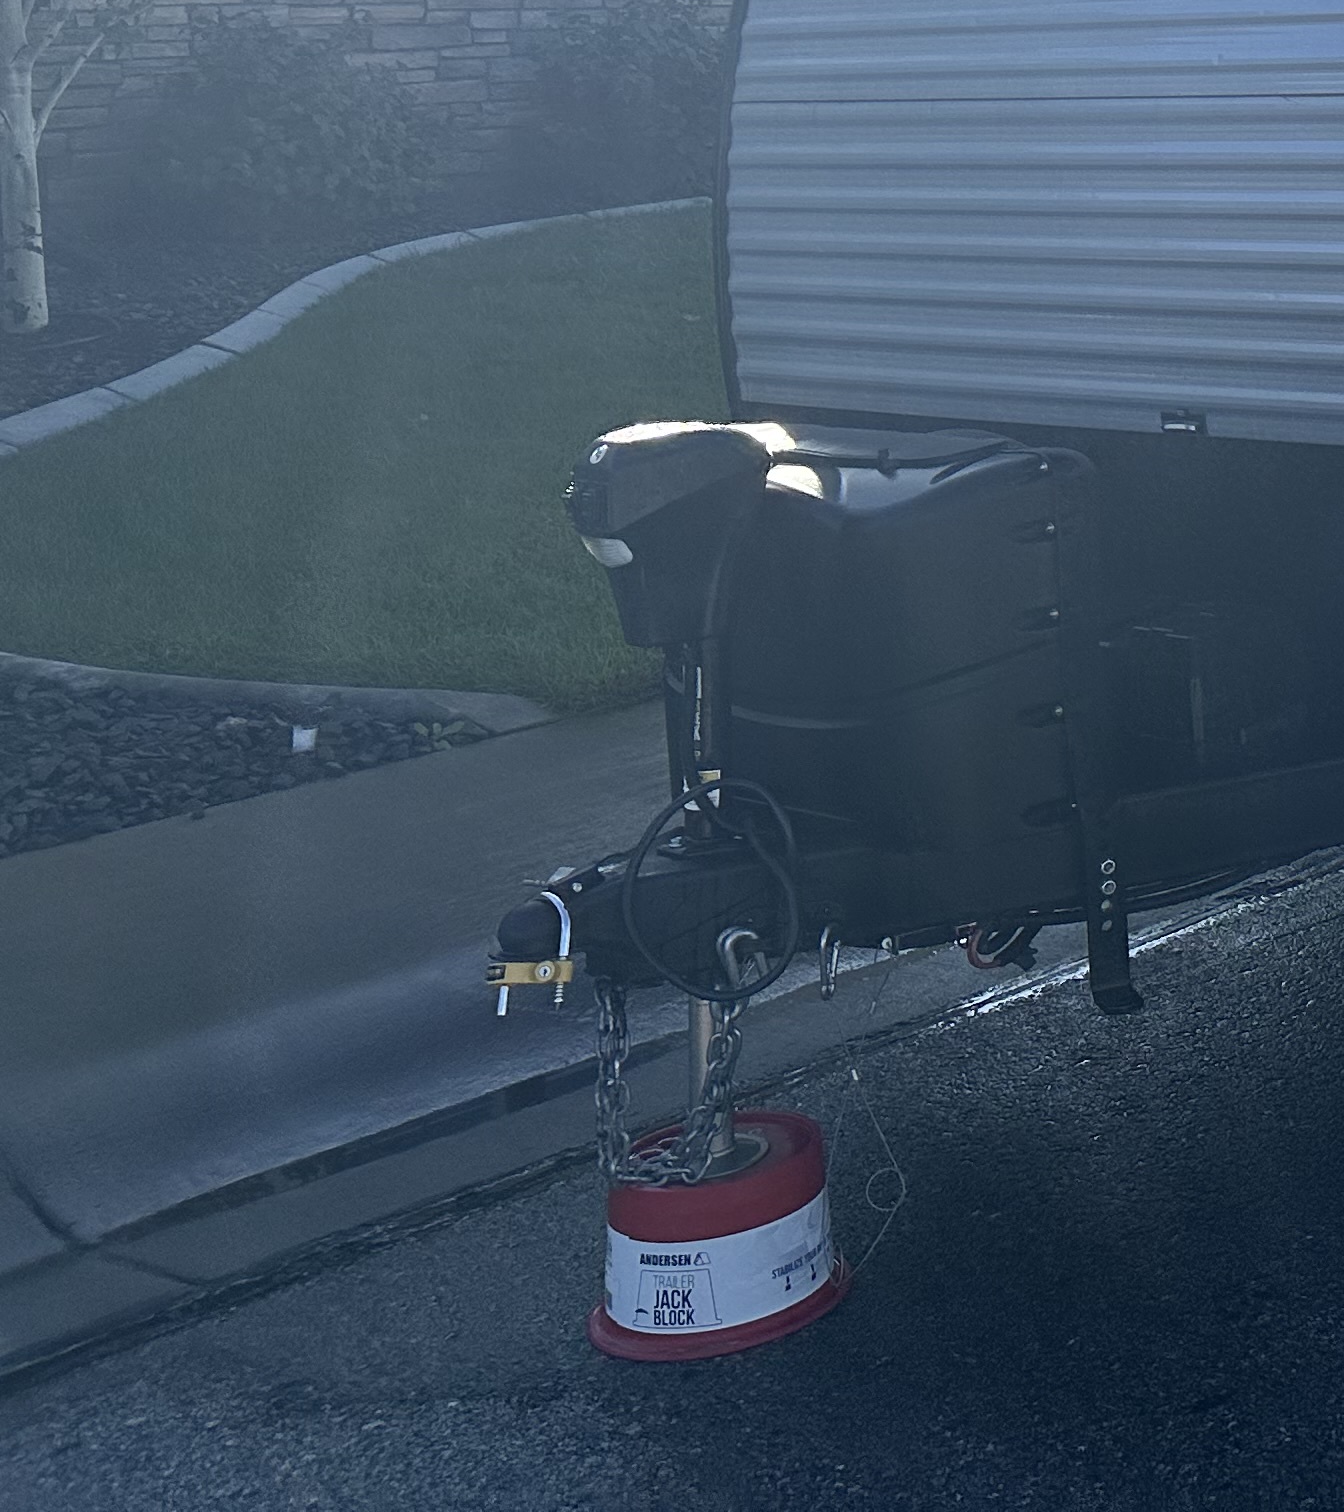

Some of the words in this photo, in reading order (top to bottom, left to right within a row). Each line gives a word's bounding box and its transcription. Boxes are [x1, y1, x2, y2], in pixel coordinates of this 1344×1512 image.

[640, 1253, 692, 1267] ANDERSEN
[653, 1274, 696, 1289] TRAILER
[653, 1288, 693, 1309] JACK
[653, 1309, 696, 1326] BLOCK
